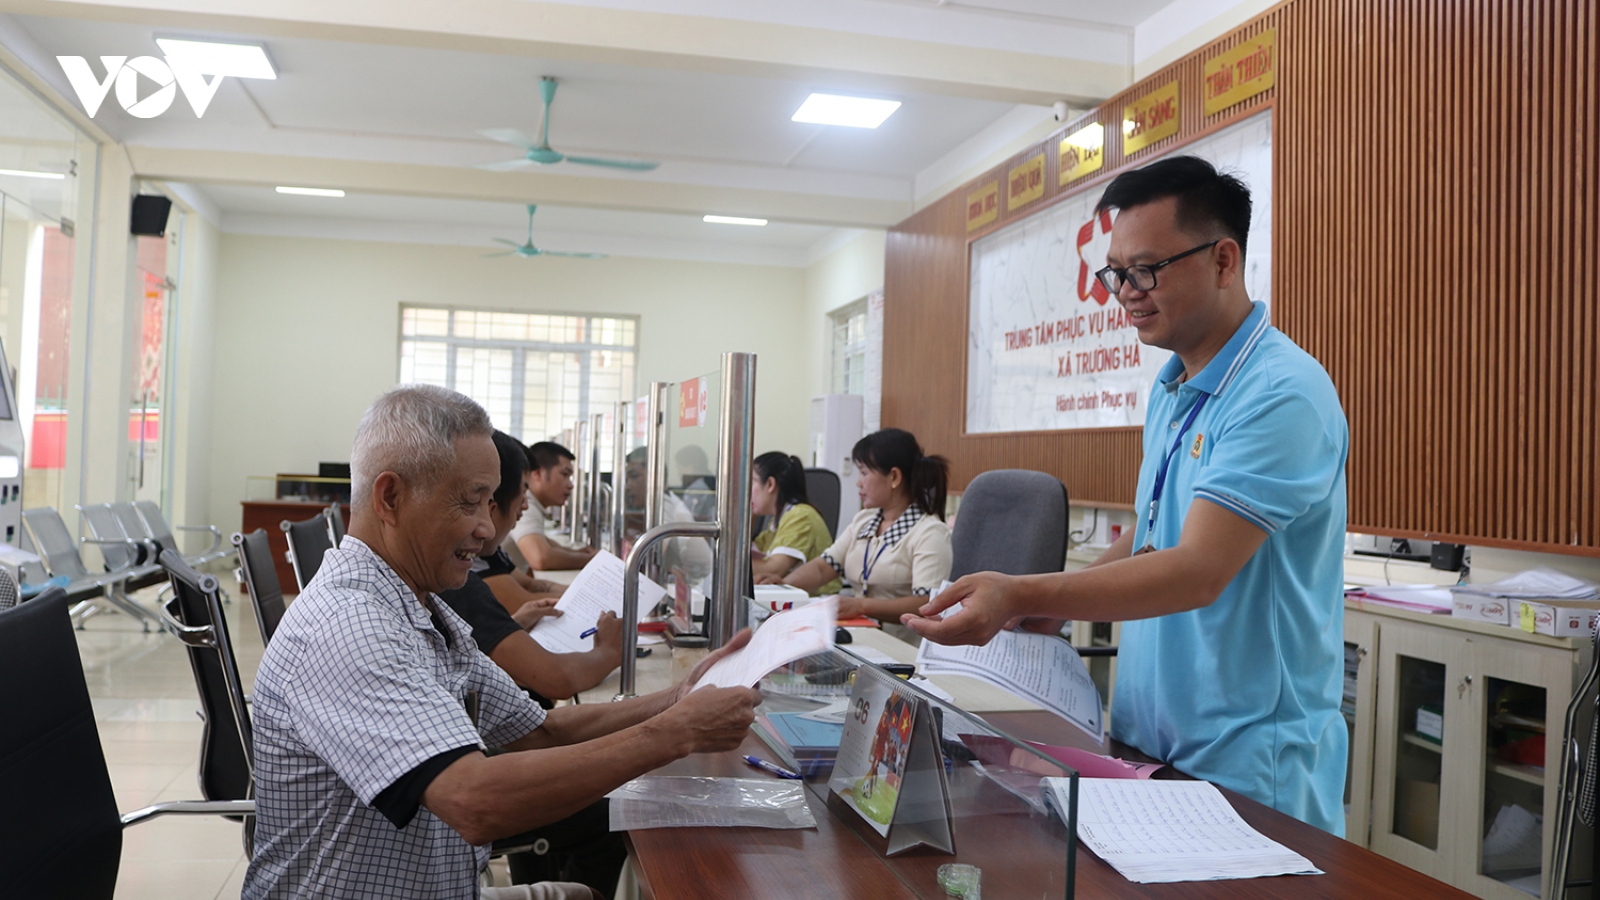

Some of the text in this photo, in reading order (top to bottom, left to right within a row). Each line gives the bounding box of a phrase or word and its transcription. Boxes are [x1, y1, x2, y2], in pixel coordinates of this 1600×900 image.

[1236, 44, 1273, 86] THIỆN
[1148, 96, 1175, 130] SÀNG
[1005, 330, 1032, 352] TRUNG
[1035, 322, 1054, 345] TÂM
[1057, 316, 1085, 343] PHỤC
[1089, 311, 1105, 338] VỤ
[1057, 351, 1072, 378] XÃ
[1076, 344, 1120, 375] TRƯỜNG
[1056, 390, 1137, 412] Hành chính Phục vụ
[854, 697, 870, 725] 06
